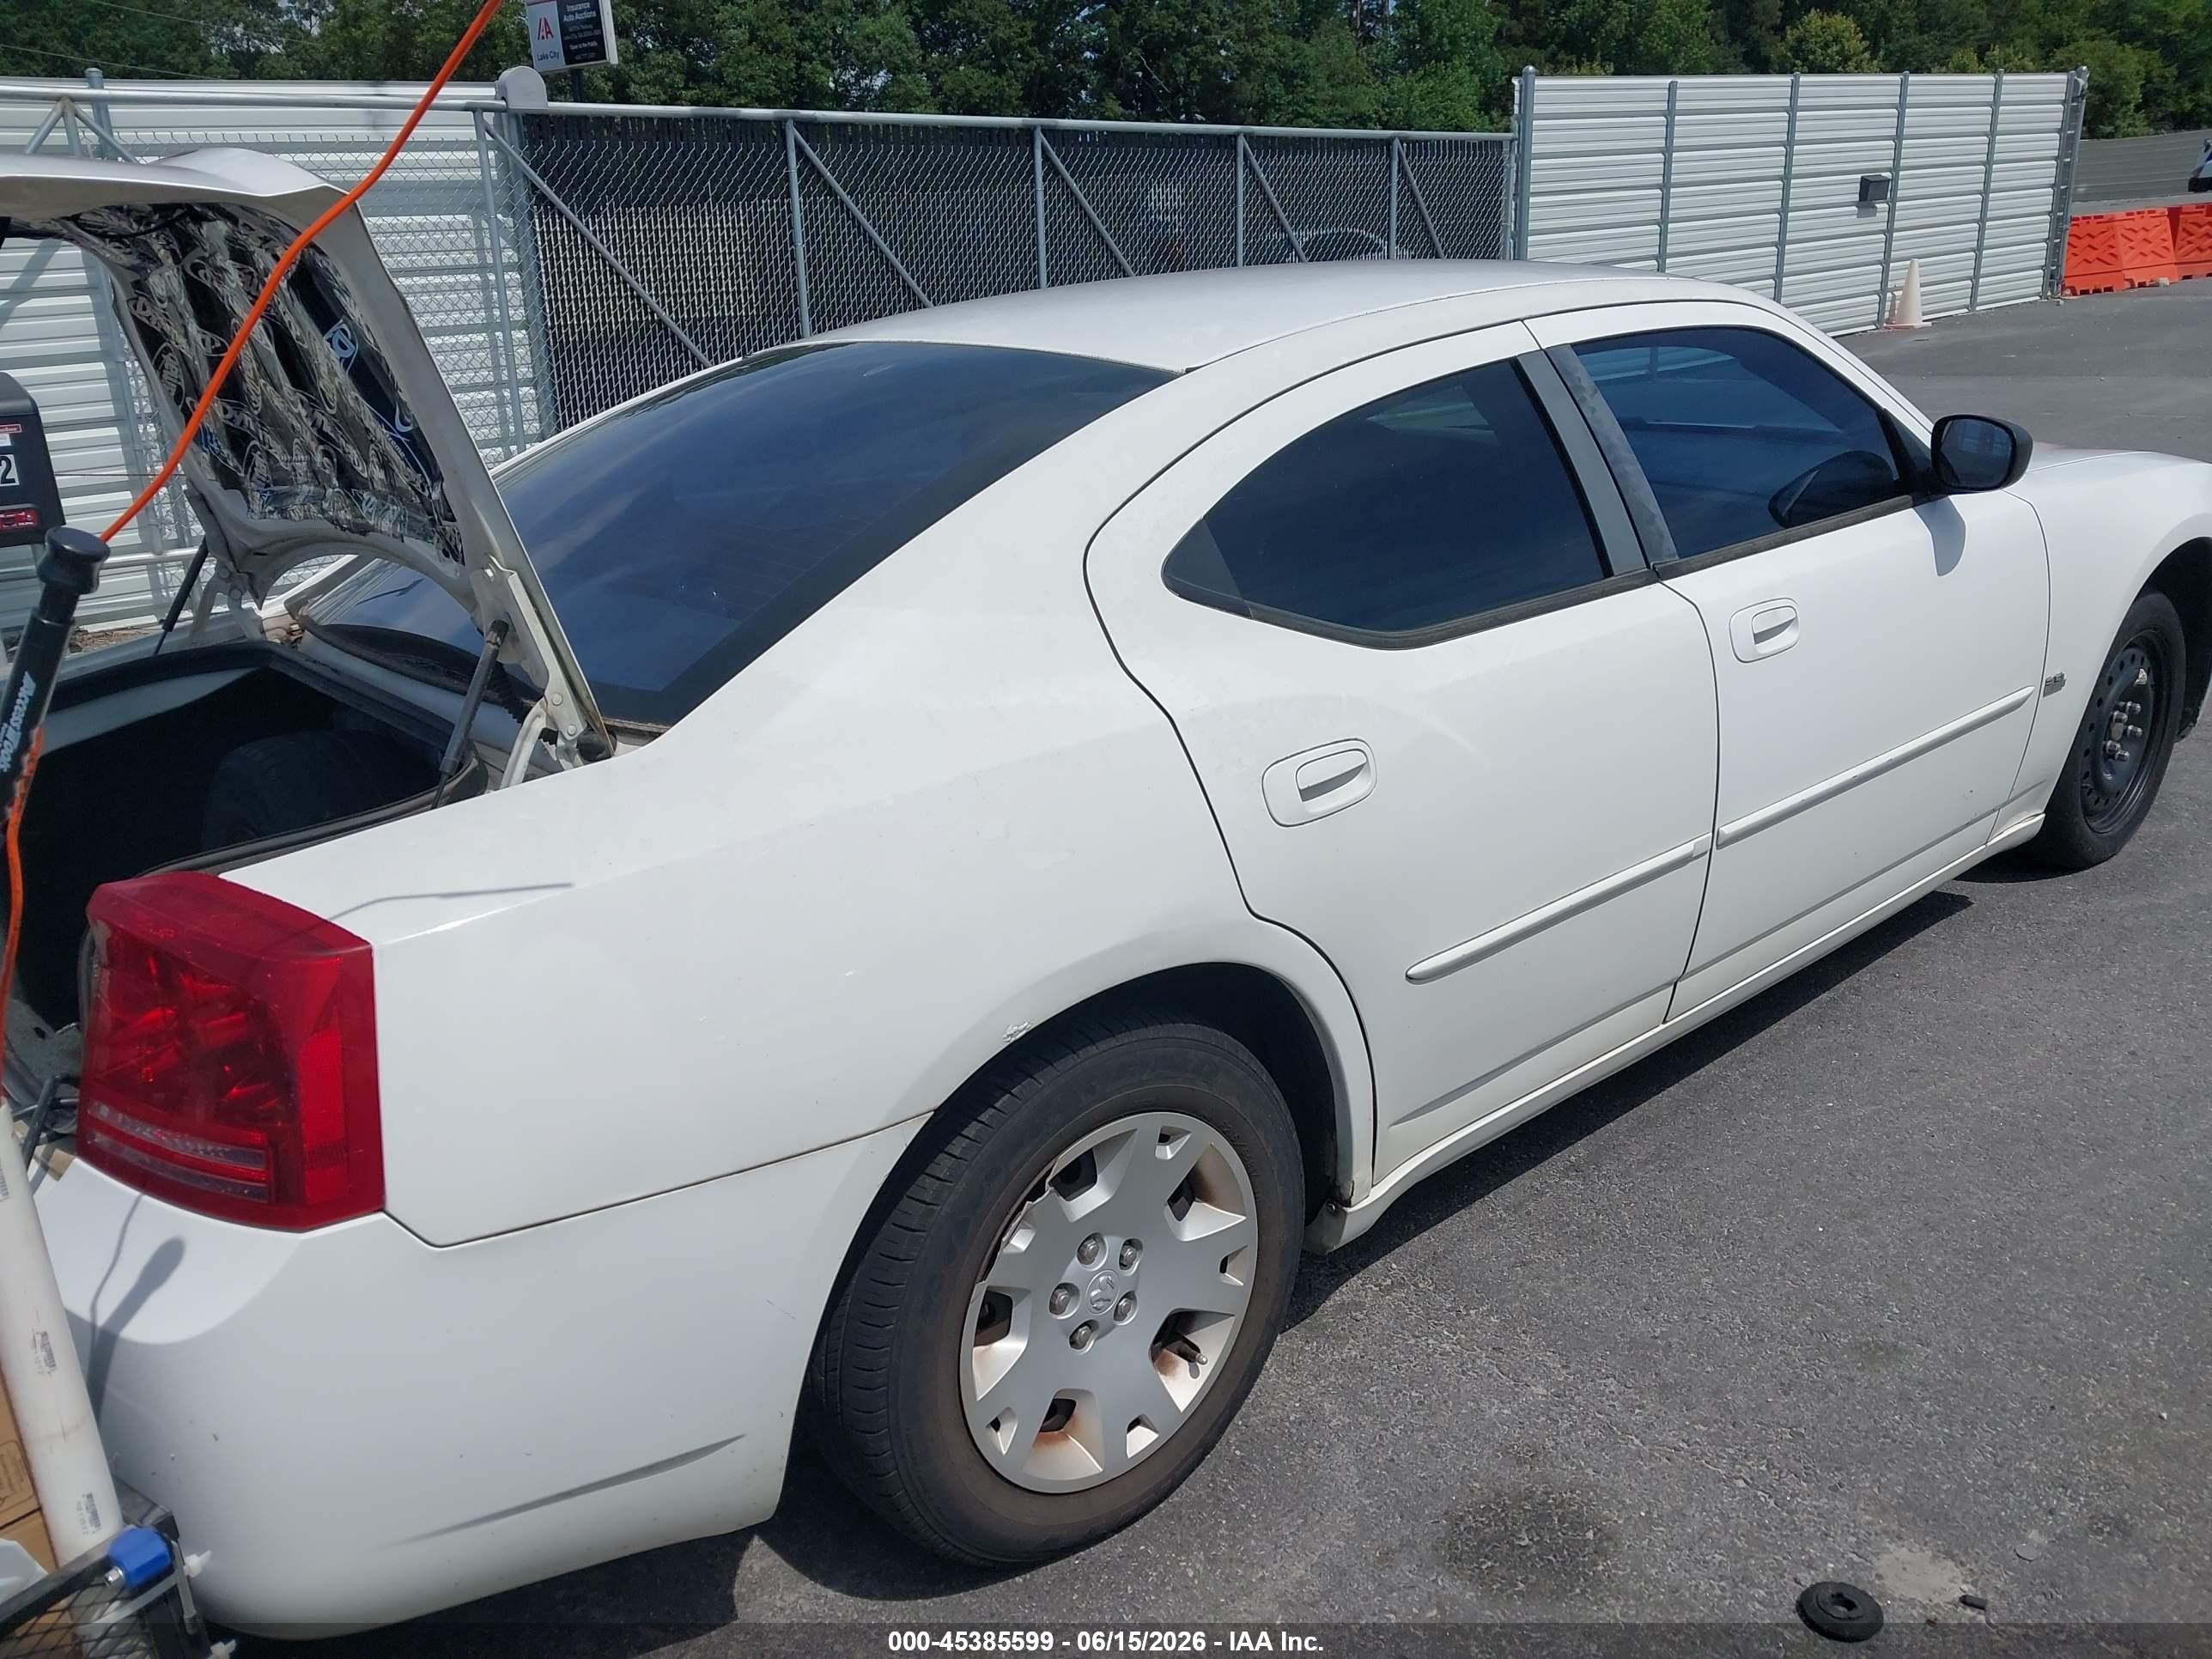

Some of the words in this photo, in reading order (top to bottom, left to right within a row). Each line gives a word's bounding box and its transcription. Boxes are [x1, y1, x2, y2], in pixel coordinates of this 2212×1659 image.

[567, 3, 590, 11] Insurance
[575, 11, 596, 20] Auctions
[537, 53, 549, 62] Lake
[550, 51, 559, 59] City
